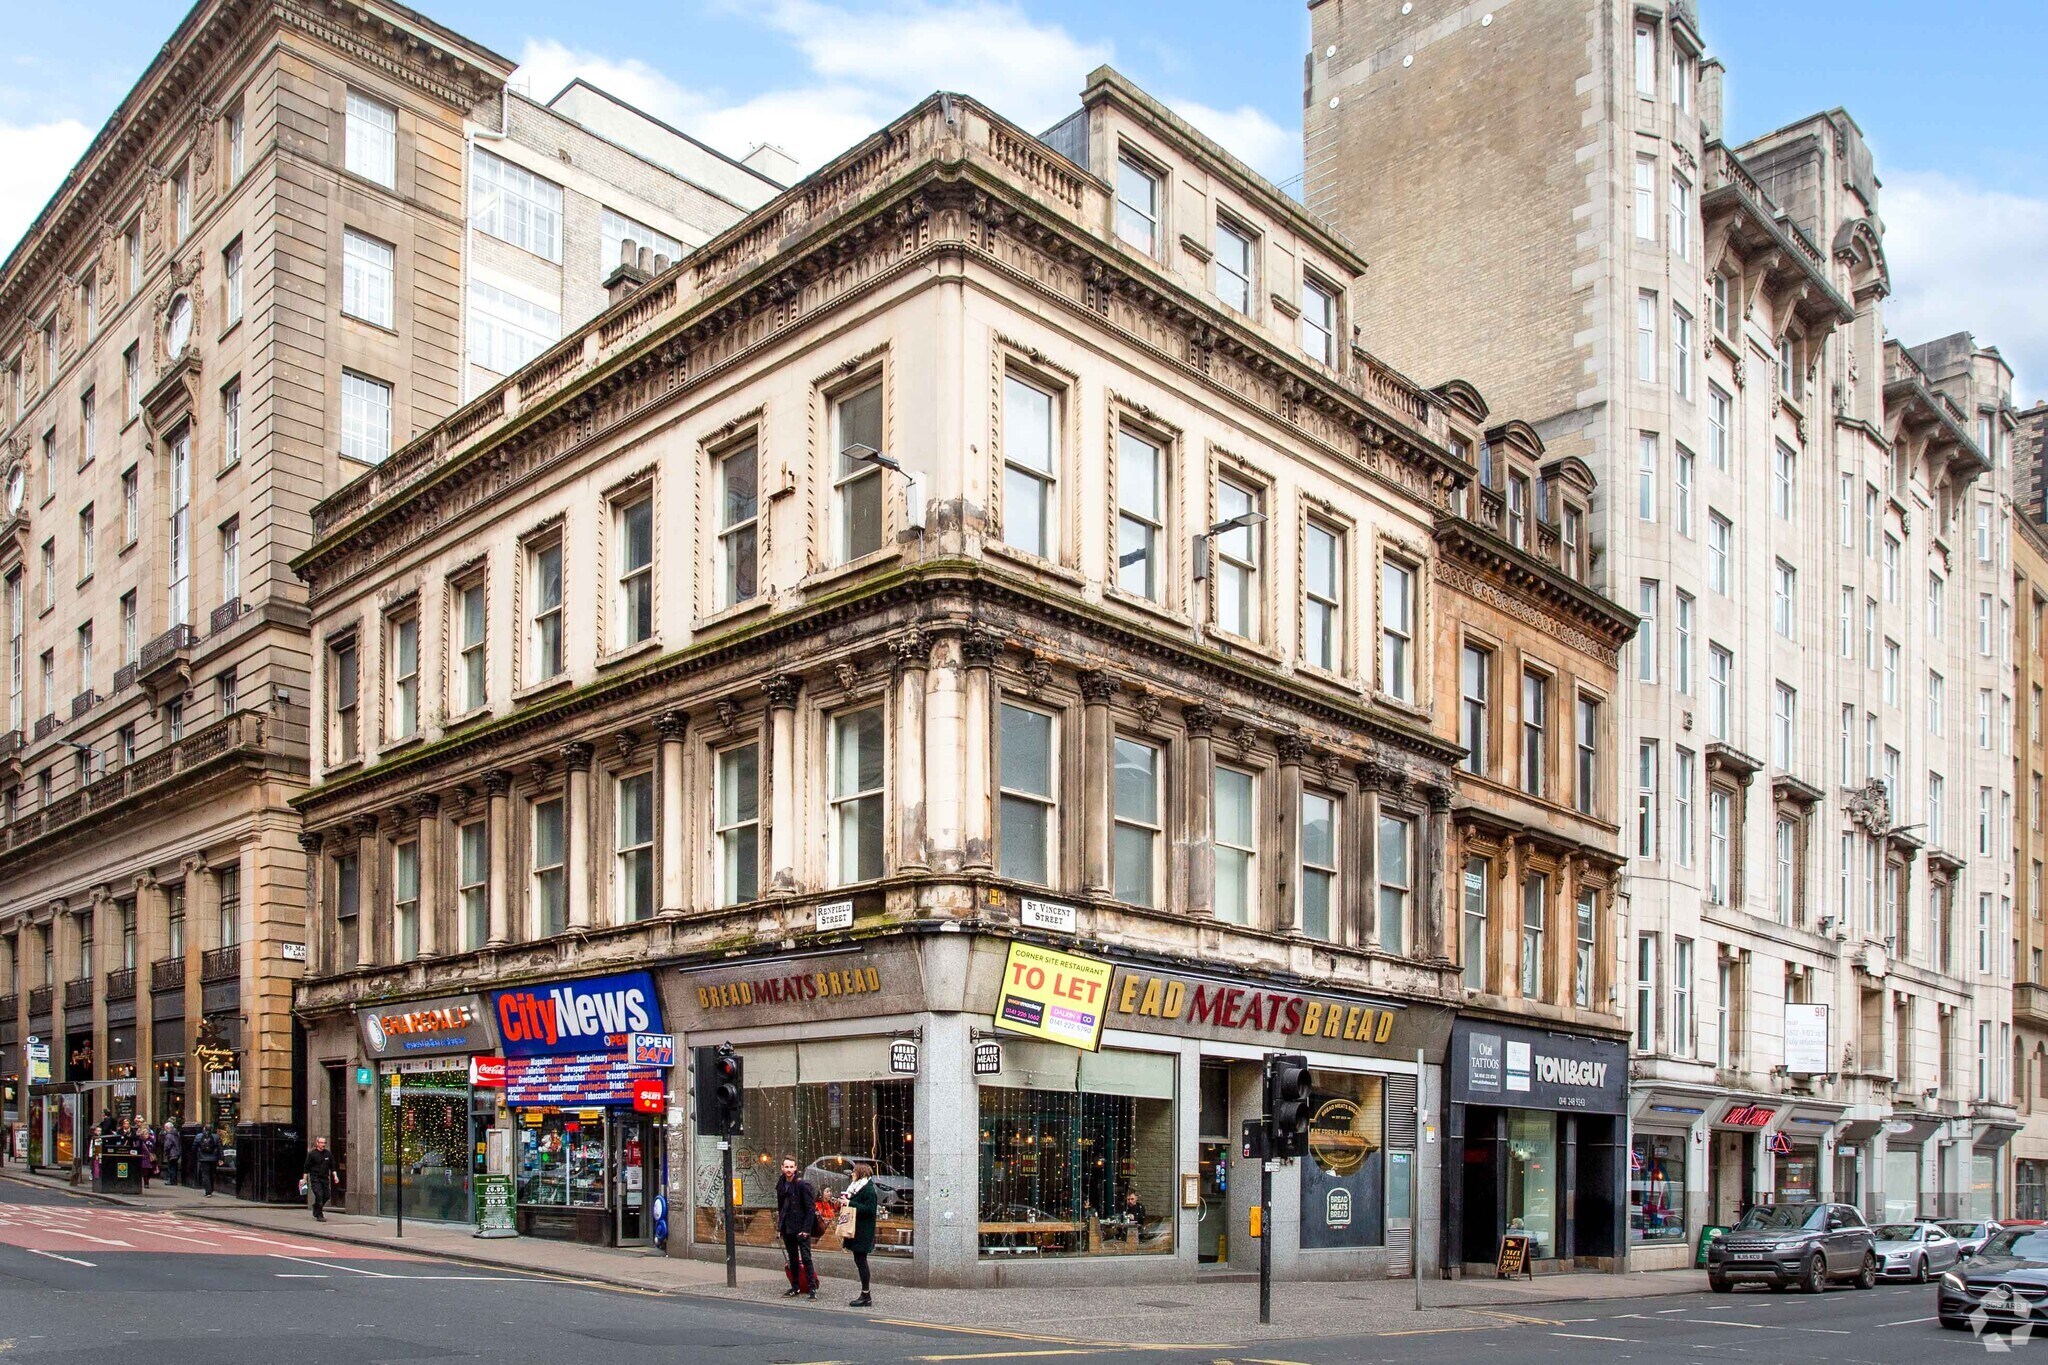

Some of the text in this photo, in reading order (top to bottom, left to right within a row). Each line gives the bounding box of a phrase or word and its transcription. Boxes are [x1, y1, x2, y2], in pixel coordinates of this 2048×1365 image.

[817, 904, 851, 917] RENFIELD
[1040, 904, 1071, 917] VINCENT
[821, 914, 847, 925] STREET
[1035, 912, 1063, 925] STREET
[1015, 949, 1104, 976] CORNER SITE RESTAURANT
[1012, 962, 1102, 1004] TO LET
[1109, 974, 1187, 1019] EAD
[1814, 1007, 1826, 1017] 90
[1049, 1017, 1062, 1027] 0141
[1063, 1021, 1075, 1030] 222
[637, 1036, 672, 1048] OPEN
[637, 1047, 672, 1063] 24/7
[893, 1046, 915, 1054] BREAD
[977, 1047, 999, 1055] BREAD
[893, 1053, 916, 1062] MEATS
[976, 1055, 998, 1064] MEATS
[1471, 1057, 1500, 1069] TATTOOS
[893, 1062, 915, 1070] BREAD
[977, 1063, 998, 1071] BREAD
[1535, 1055, 1608, 1088] TONI&GUY
[210, 1069, 241, 1095] MOJITO
[640, 1091, 661, 1101] Sun
[1330, 1203, 1348, 1211] MEATS
